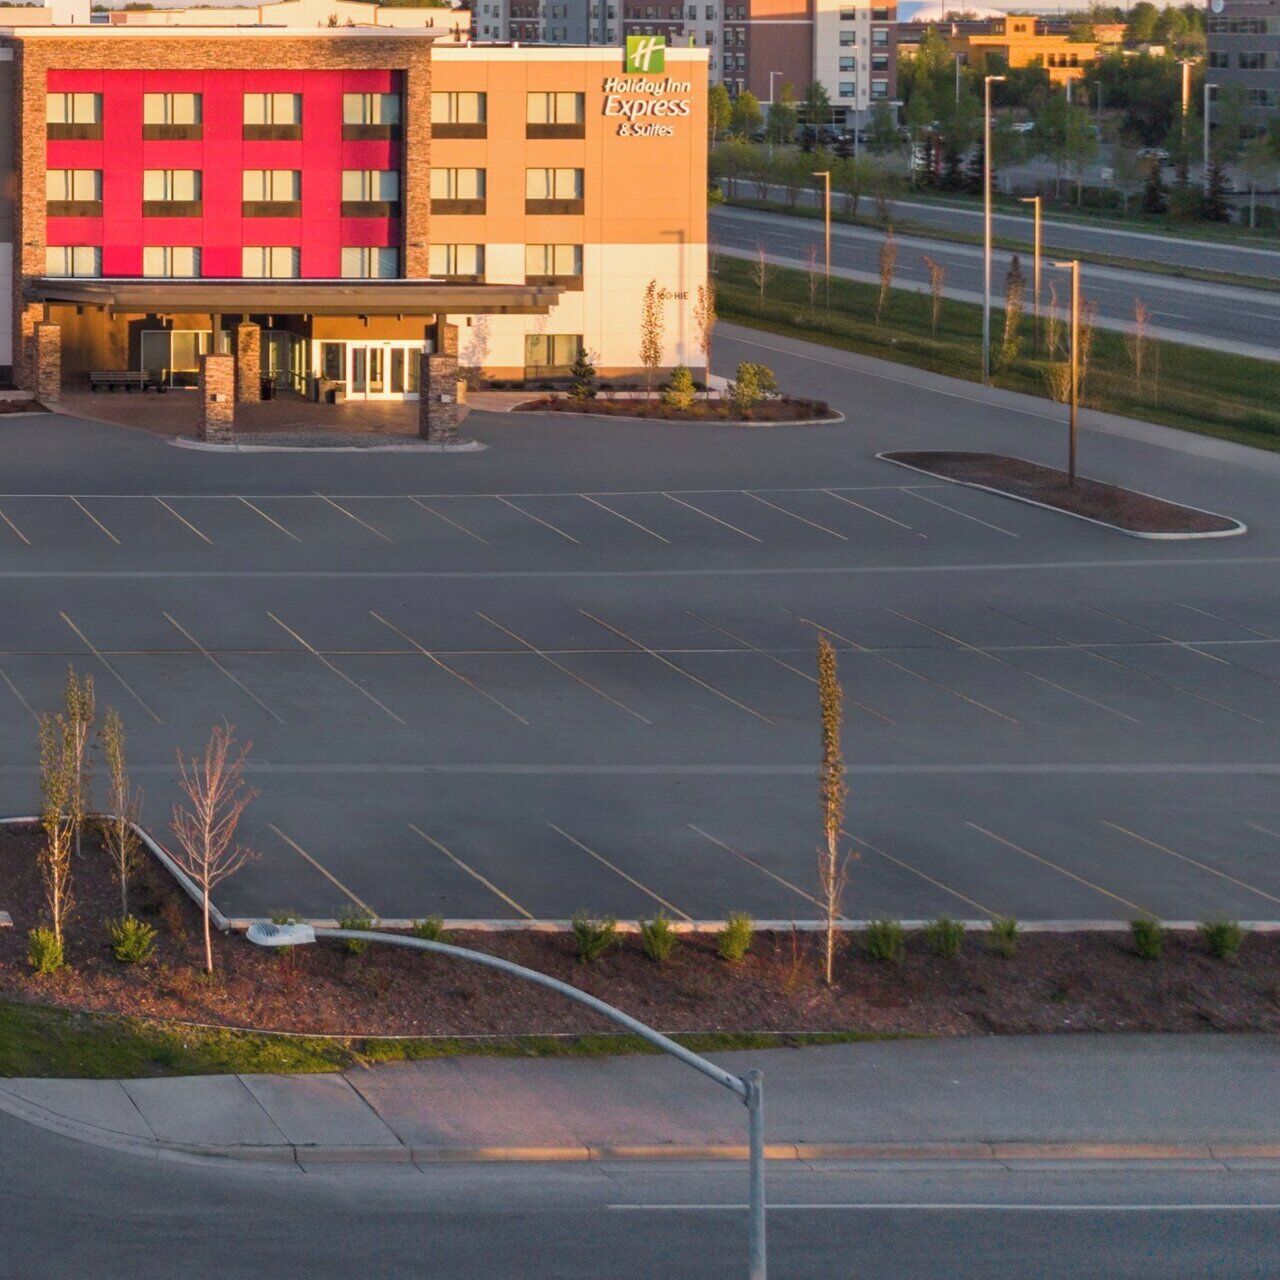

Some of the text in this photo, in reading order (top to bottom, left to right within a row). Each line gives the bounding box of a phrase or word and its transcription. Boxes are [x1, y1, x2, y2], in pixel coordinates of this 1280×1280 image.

[604, 77, 691, 96] Holiday Inn
[604, 94, 691, 121] Express
[619, 122, 673, 136] & Suites
